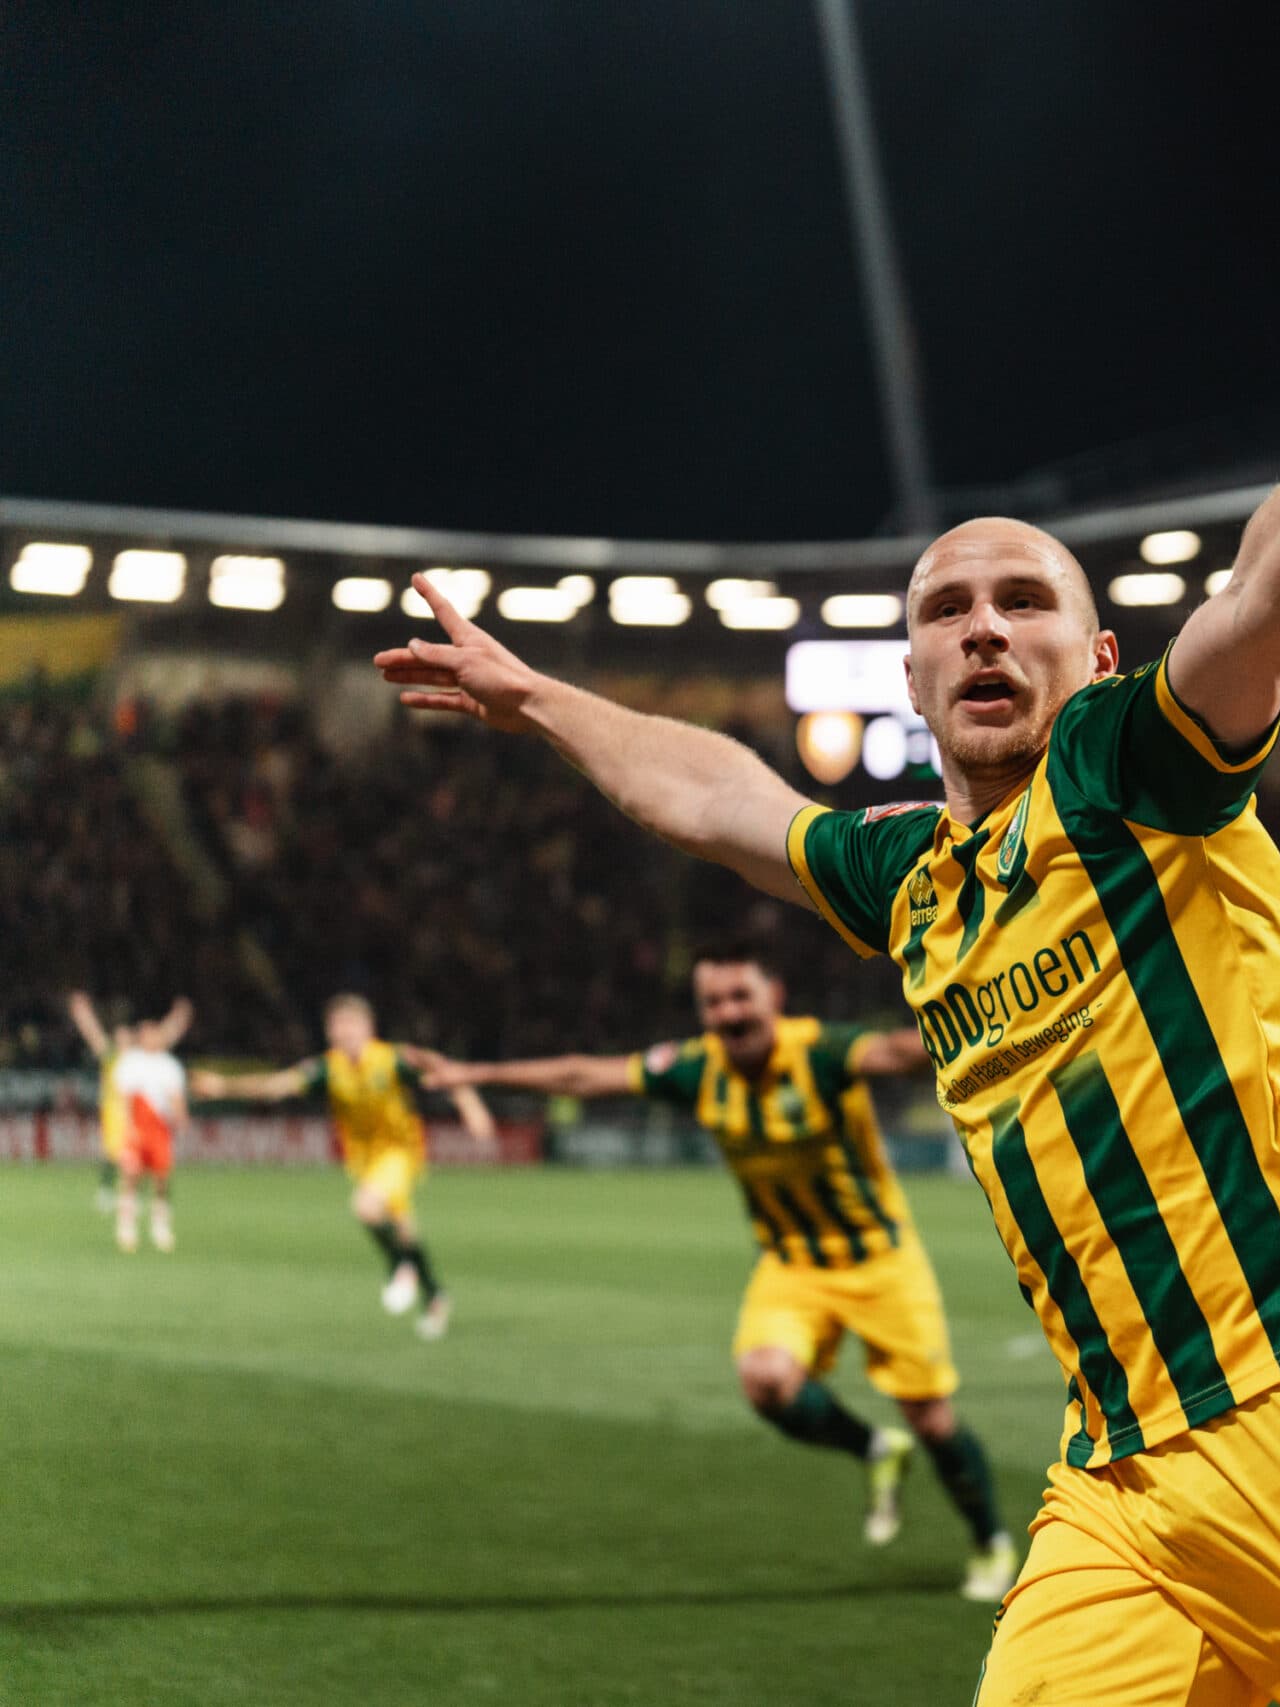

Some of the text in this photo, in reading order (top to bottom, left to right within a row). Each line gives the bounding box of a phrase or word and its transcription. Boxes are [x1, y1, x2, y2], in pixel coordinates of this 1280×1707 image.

[917, 929, 1102, 1069] ADOgroen
[1011, 1005, 1095, 1058] beweging
[1003, 1050, 1020, 1067] in
[969, 1060, 1010, 1085] Haag
[951, 1076, 980, 1098] Den
